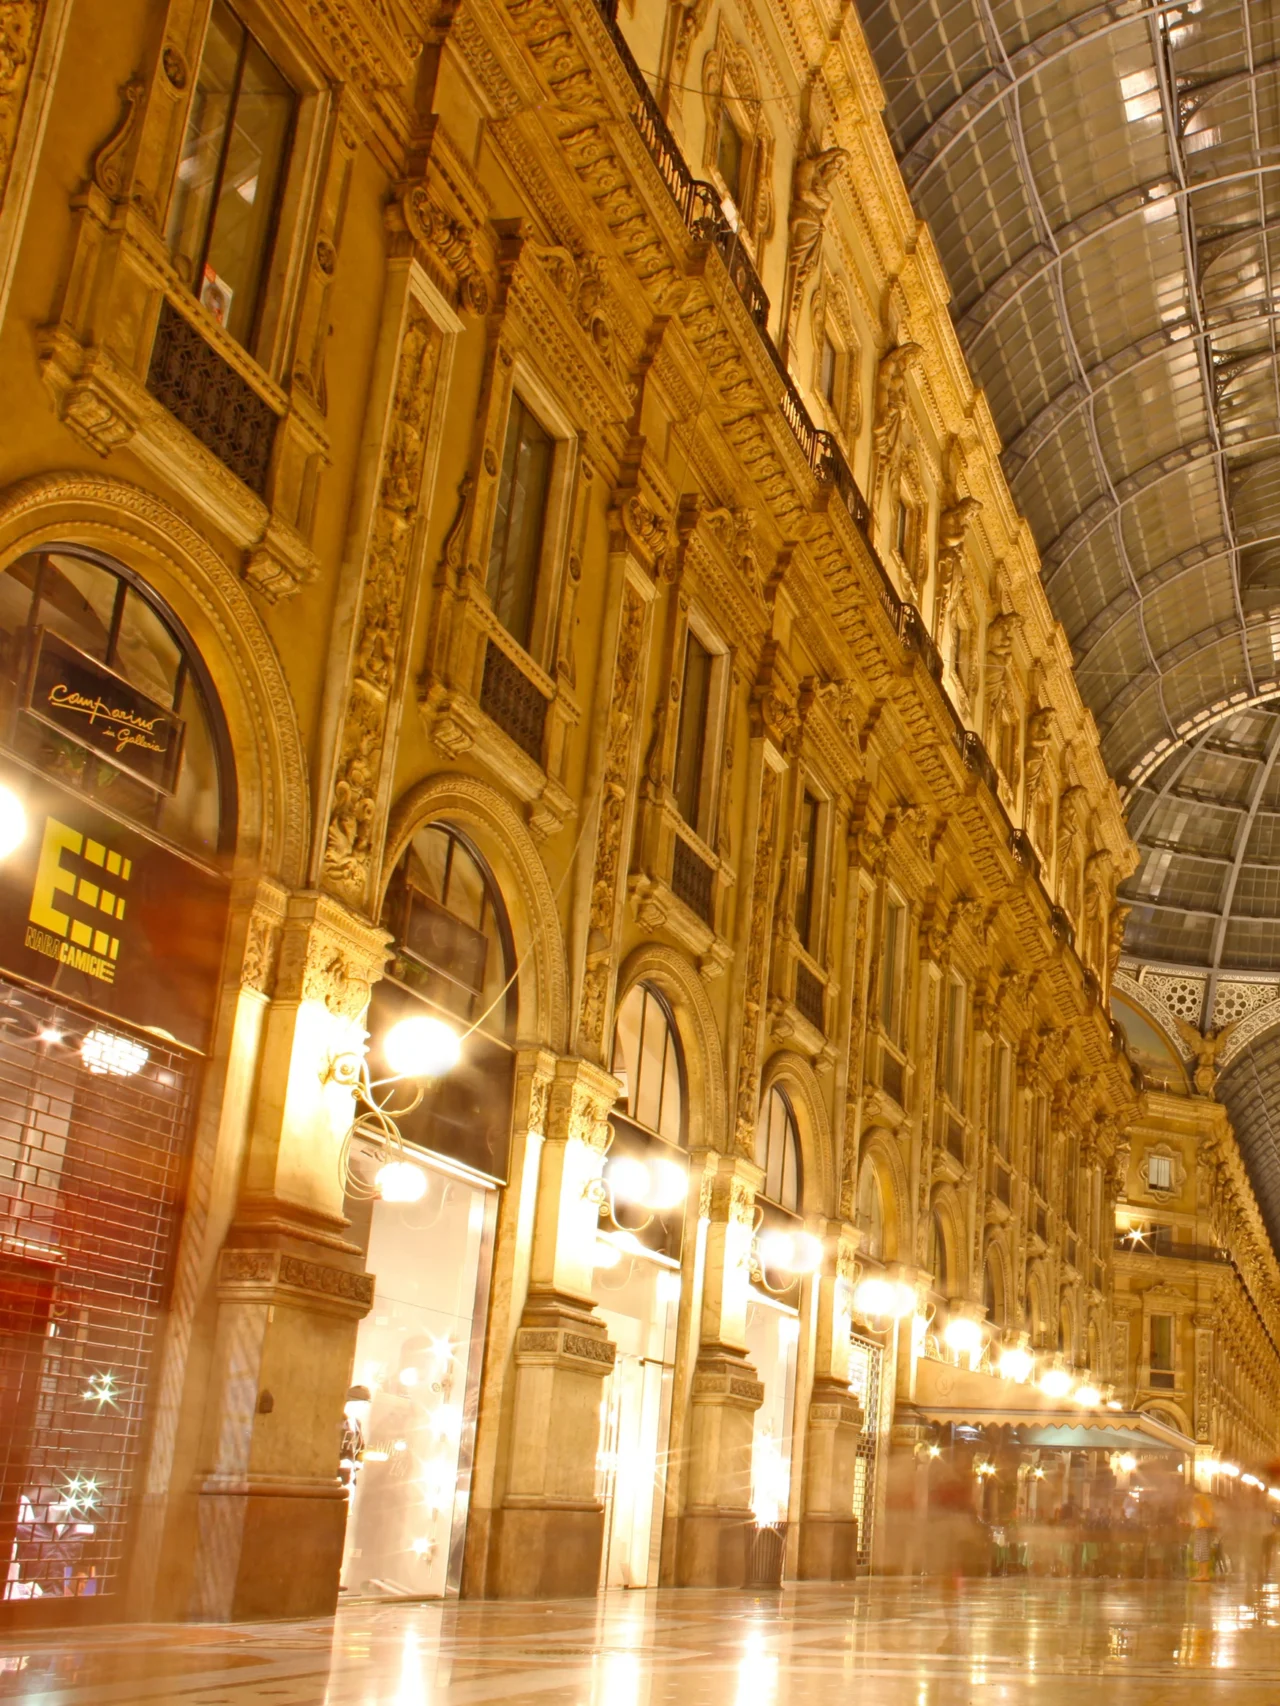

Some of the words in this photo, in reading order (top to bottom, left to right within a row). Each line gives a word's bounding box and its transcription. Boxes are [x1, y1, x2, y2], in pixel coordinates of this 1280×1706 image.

[48, 684, 165, 731] Camparino
[102, 726, 116, 738] in
[116, 728, 167, 753] Galleria
